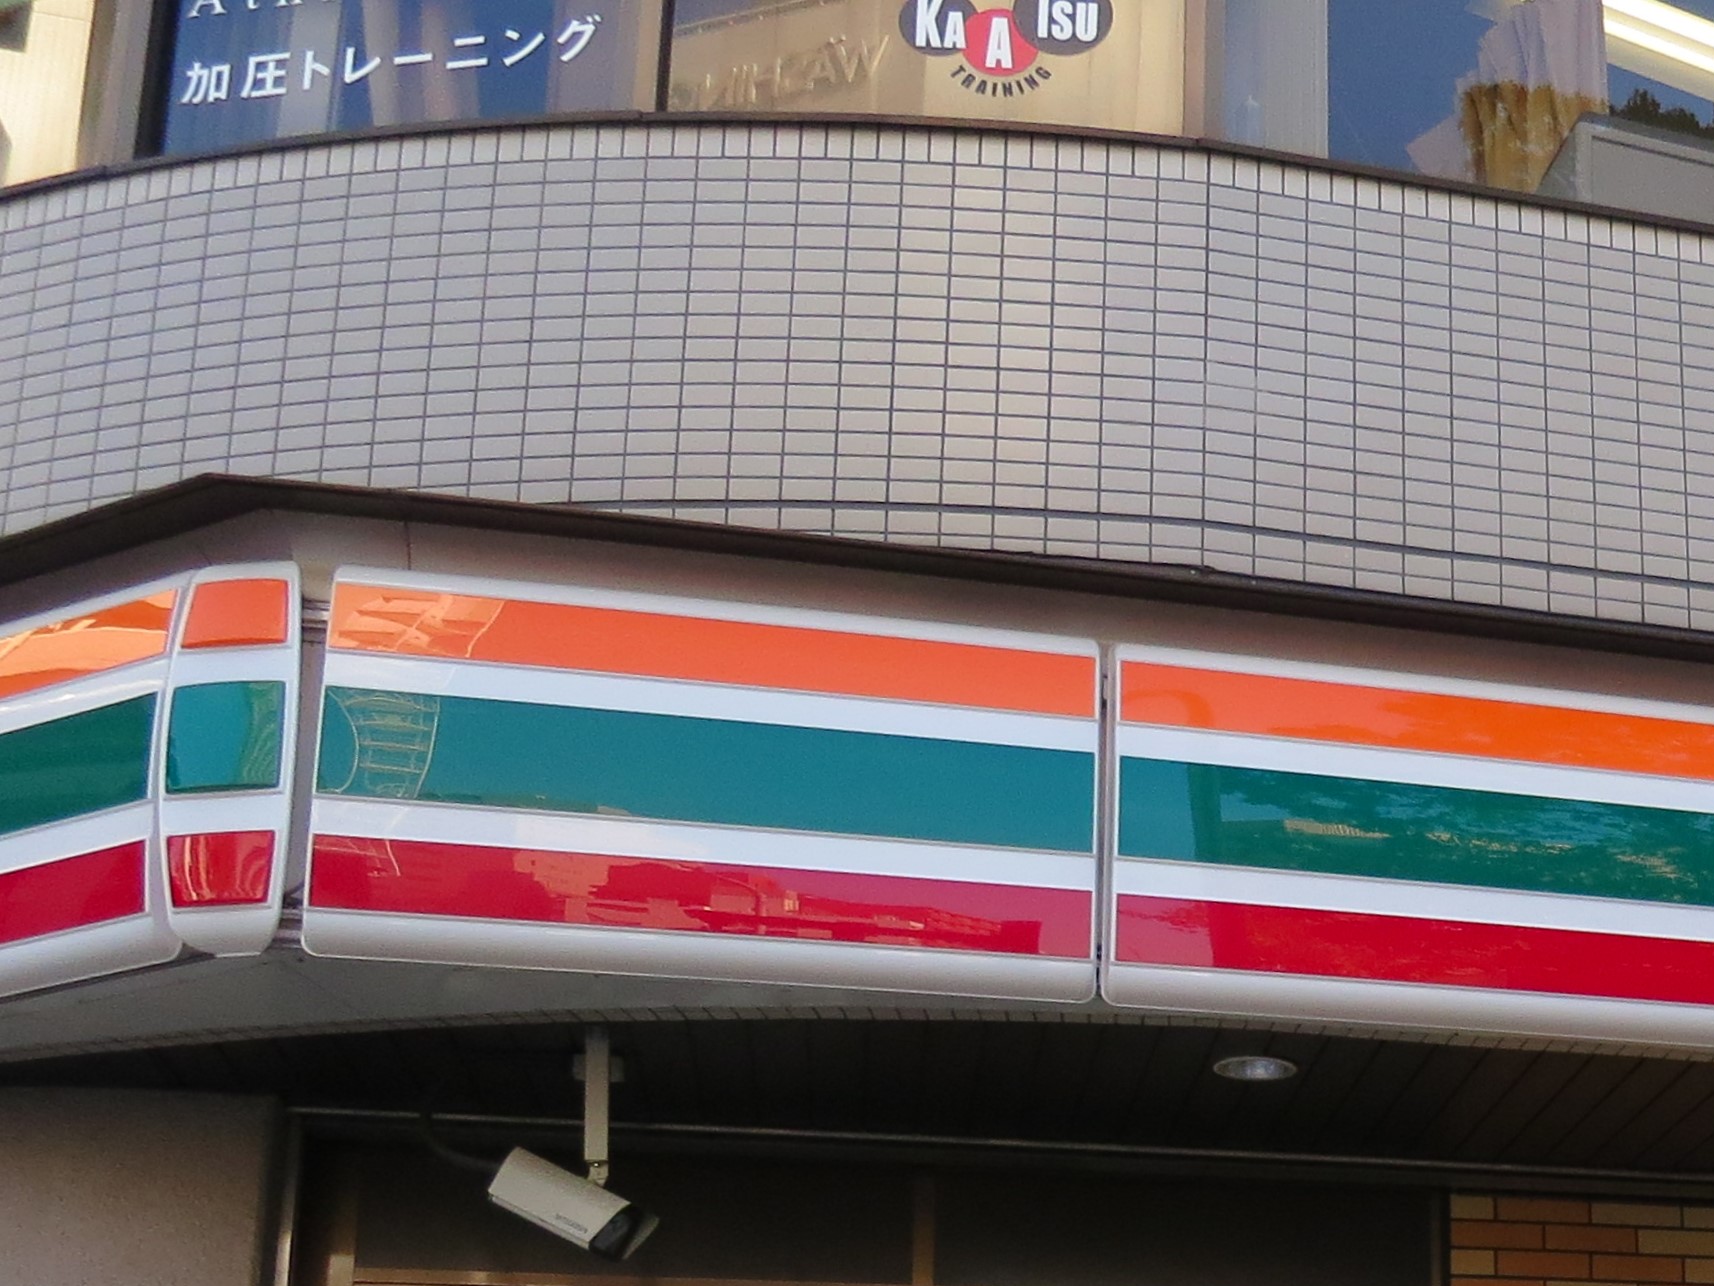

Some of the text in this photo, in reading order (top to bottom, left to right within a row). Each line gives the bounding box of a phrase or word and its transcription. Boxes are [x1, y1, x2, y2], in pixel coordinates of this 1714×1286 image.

[181, 14, 601, 104] 加圧トレーニング
[950, 65, 1052, 97] TRAINING
